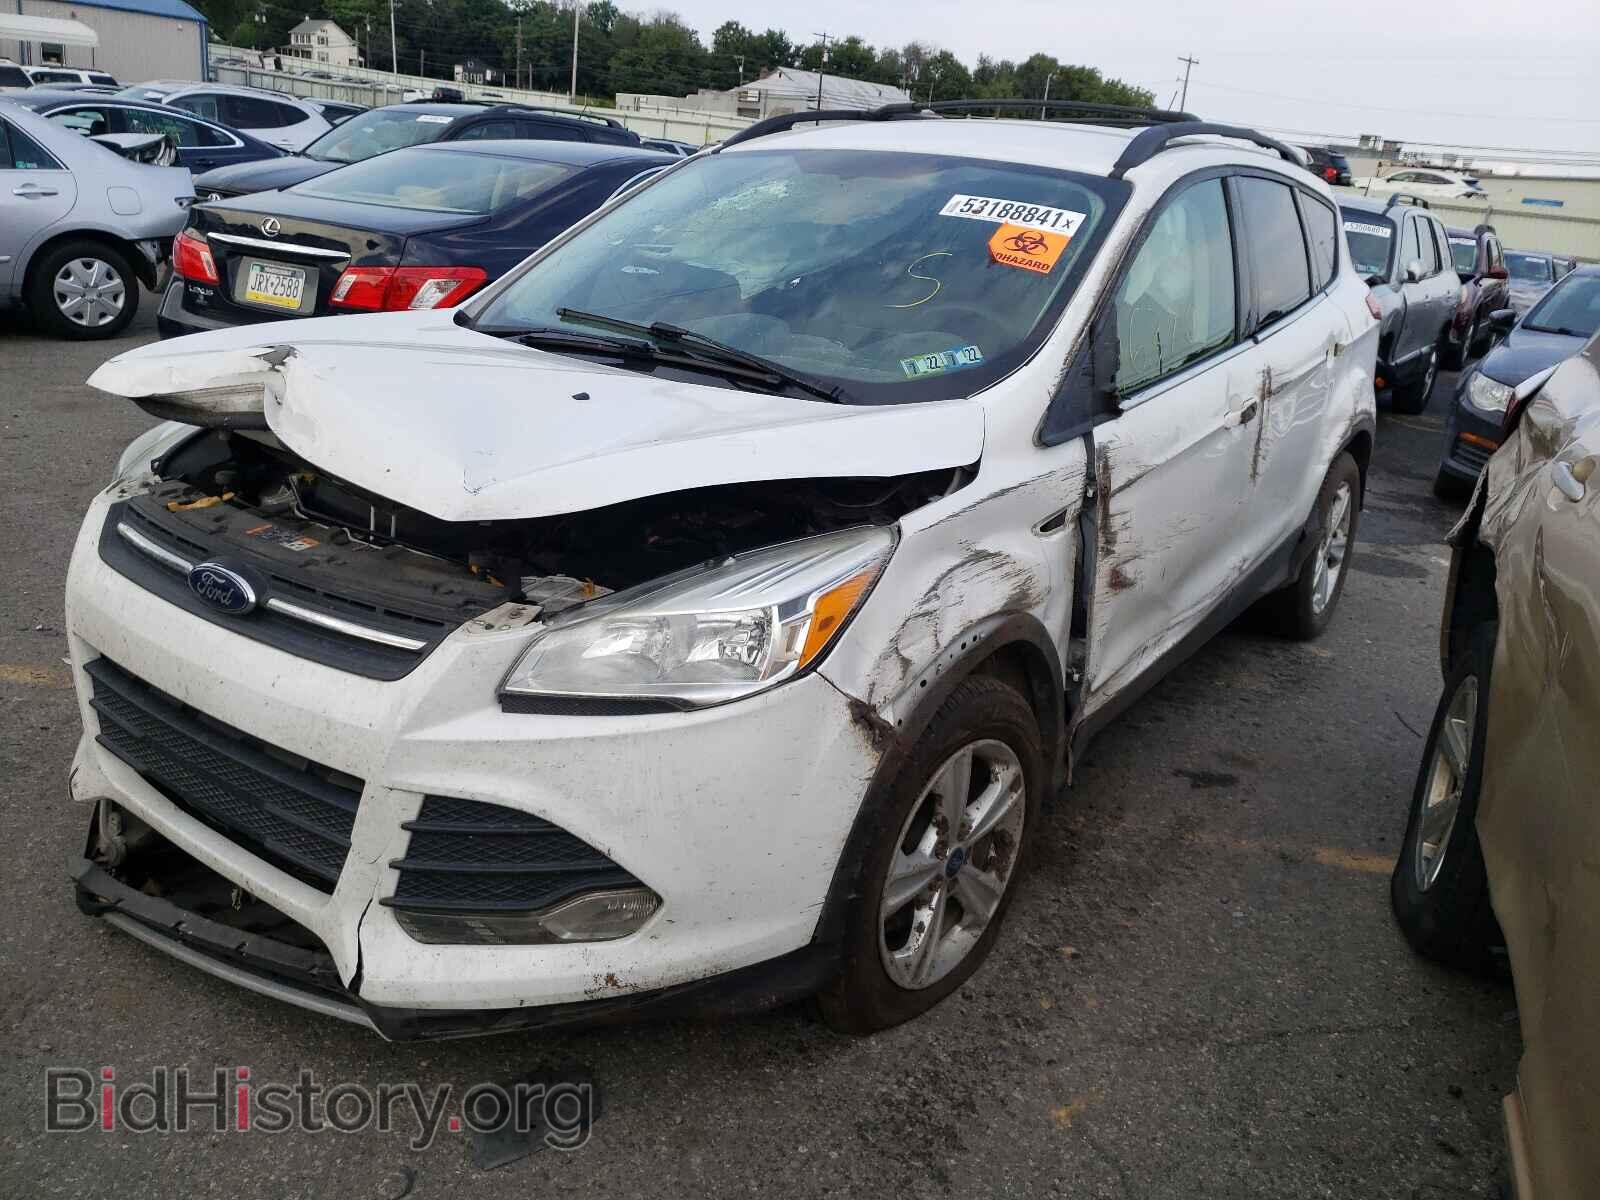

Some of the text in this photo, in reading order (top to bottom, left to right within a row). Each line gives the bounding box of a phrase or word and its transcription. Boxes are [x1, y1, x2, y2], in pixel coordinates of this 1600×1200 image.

[995, 252, 1051, 271] OHAZARD
[926, 356, 941, 370] 22
[964, 347, 978, 362] 22
[196, 571, 235, 606] Ford
